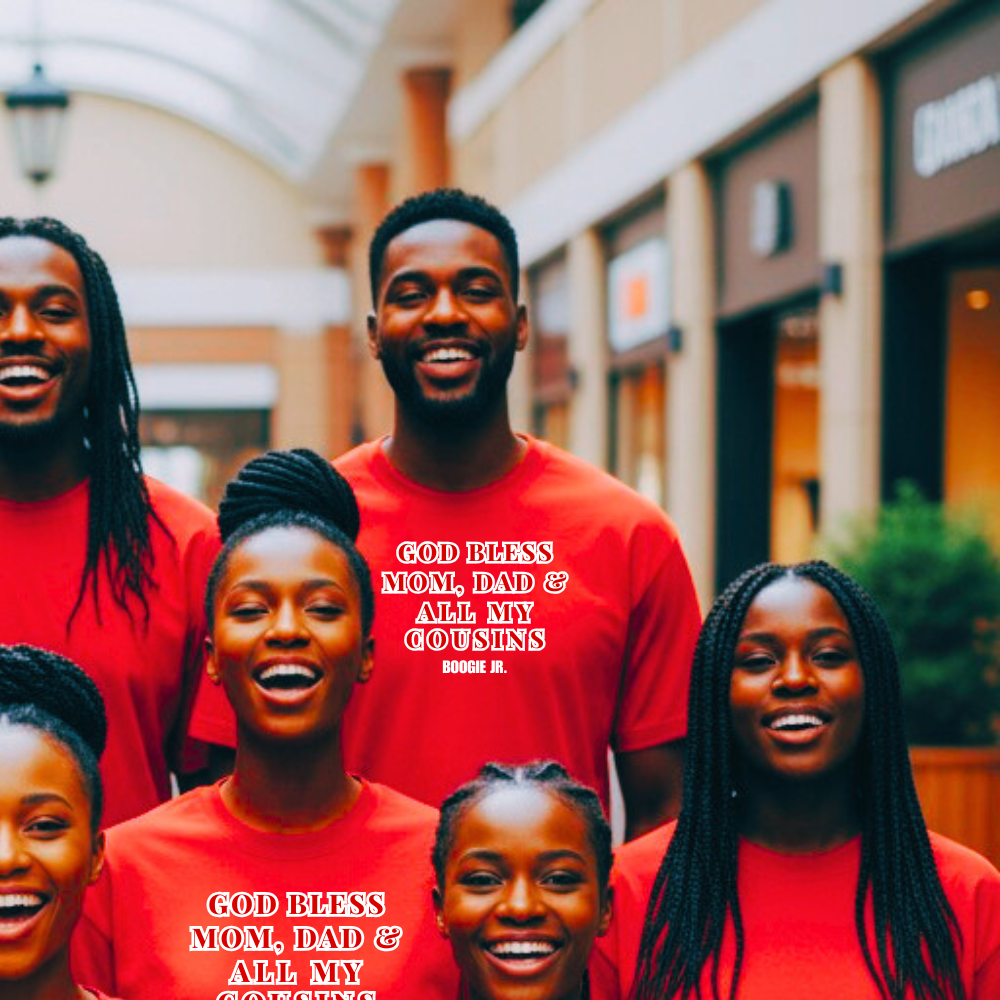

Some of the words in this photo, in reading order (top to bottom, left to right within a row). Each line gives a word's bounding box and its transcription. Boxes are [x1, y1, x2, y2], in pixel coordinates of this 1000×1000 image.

[395, 540, 461, 565] GOD
[465, 540, 555, 565] BLESS
[381, 570, 465, 598] MOM,
[472, 570, 536, 595] DAD
[542, 570, 570, 595] &
[414, 600, 477, 625] ALL
[486, 600, 535, 625] MY
[403, 627, 546, 652] COUSINS
[442, 659, 487, 674] BOOGIE
[489, 659, 508, 674] JR.
[205, 891, 280, 918] GOD
[285, 891, 386, 918] BLESS
[188, 925, 285, 956] MOM,
[292, 925, 365, 952] DAD
[373, 925, 404, 952] &
[227, 959, 298, 986] ALL
[309, 959, 364, 986] MY
